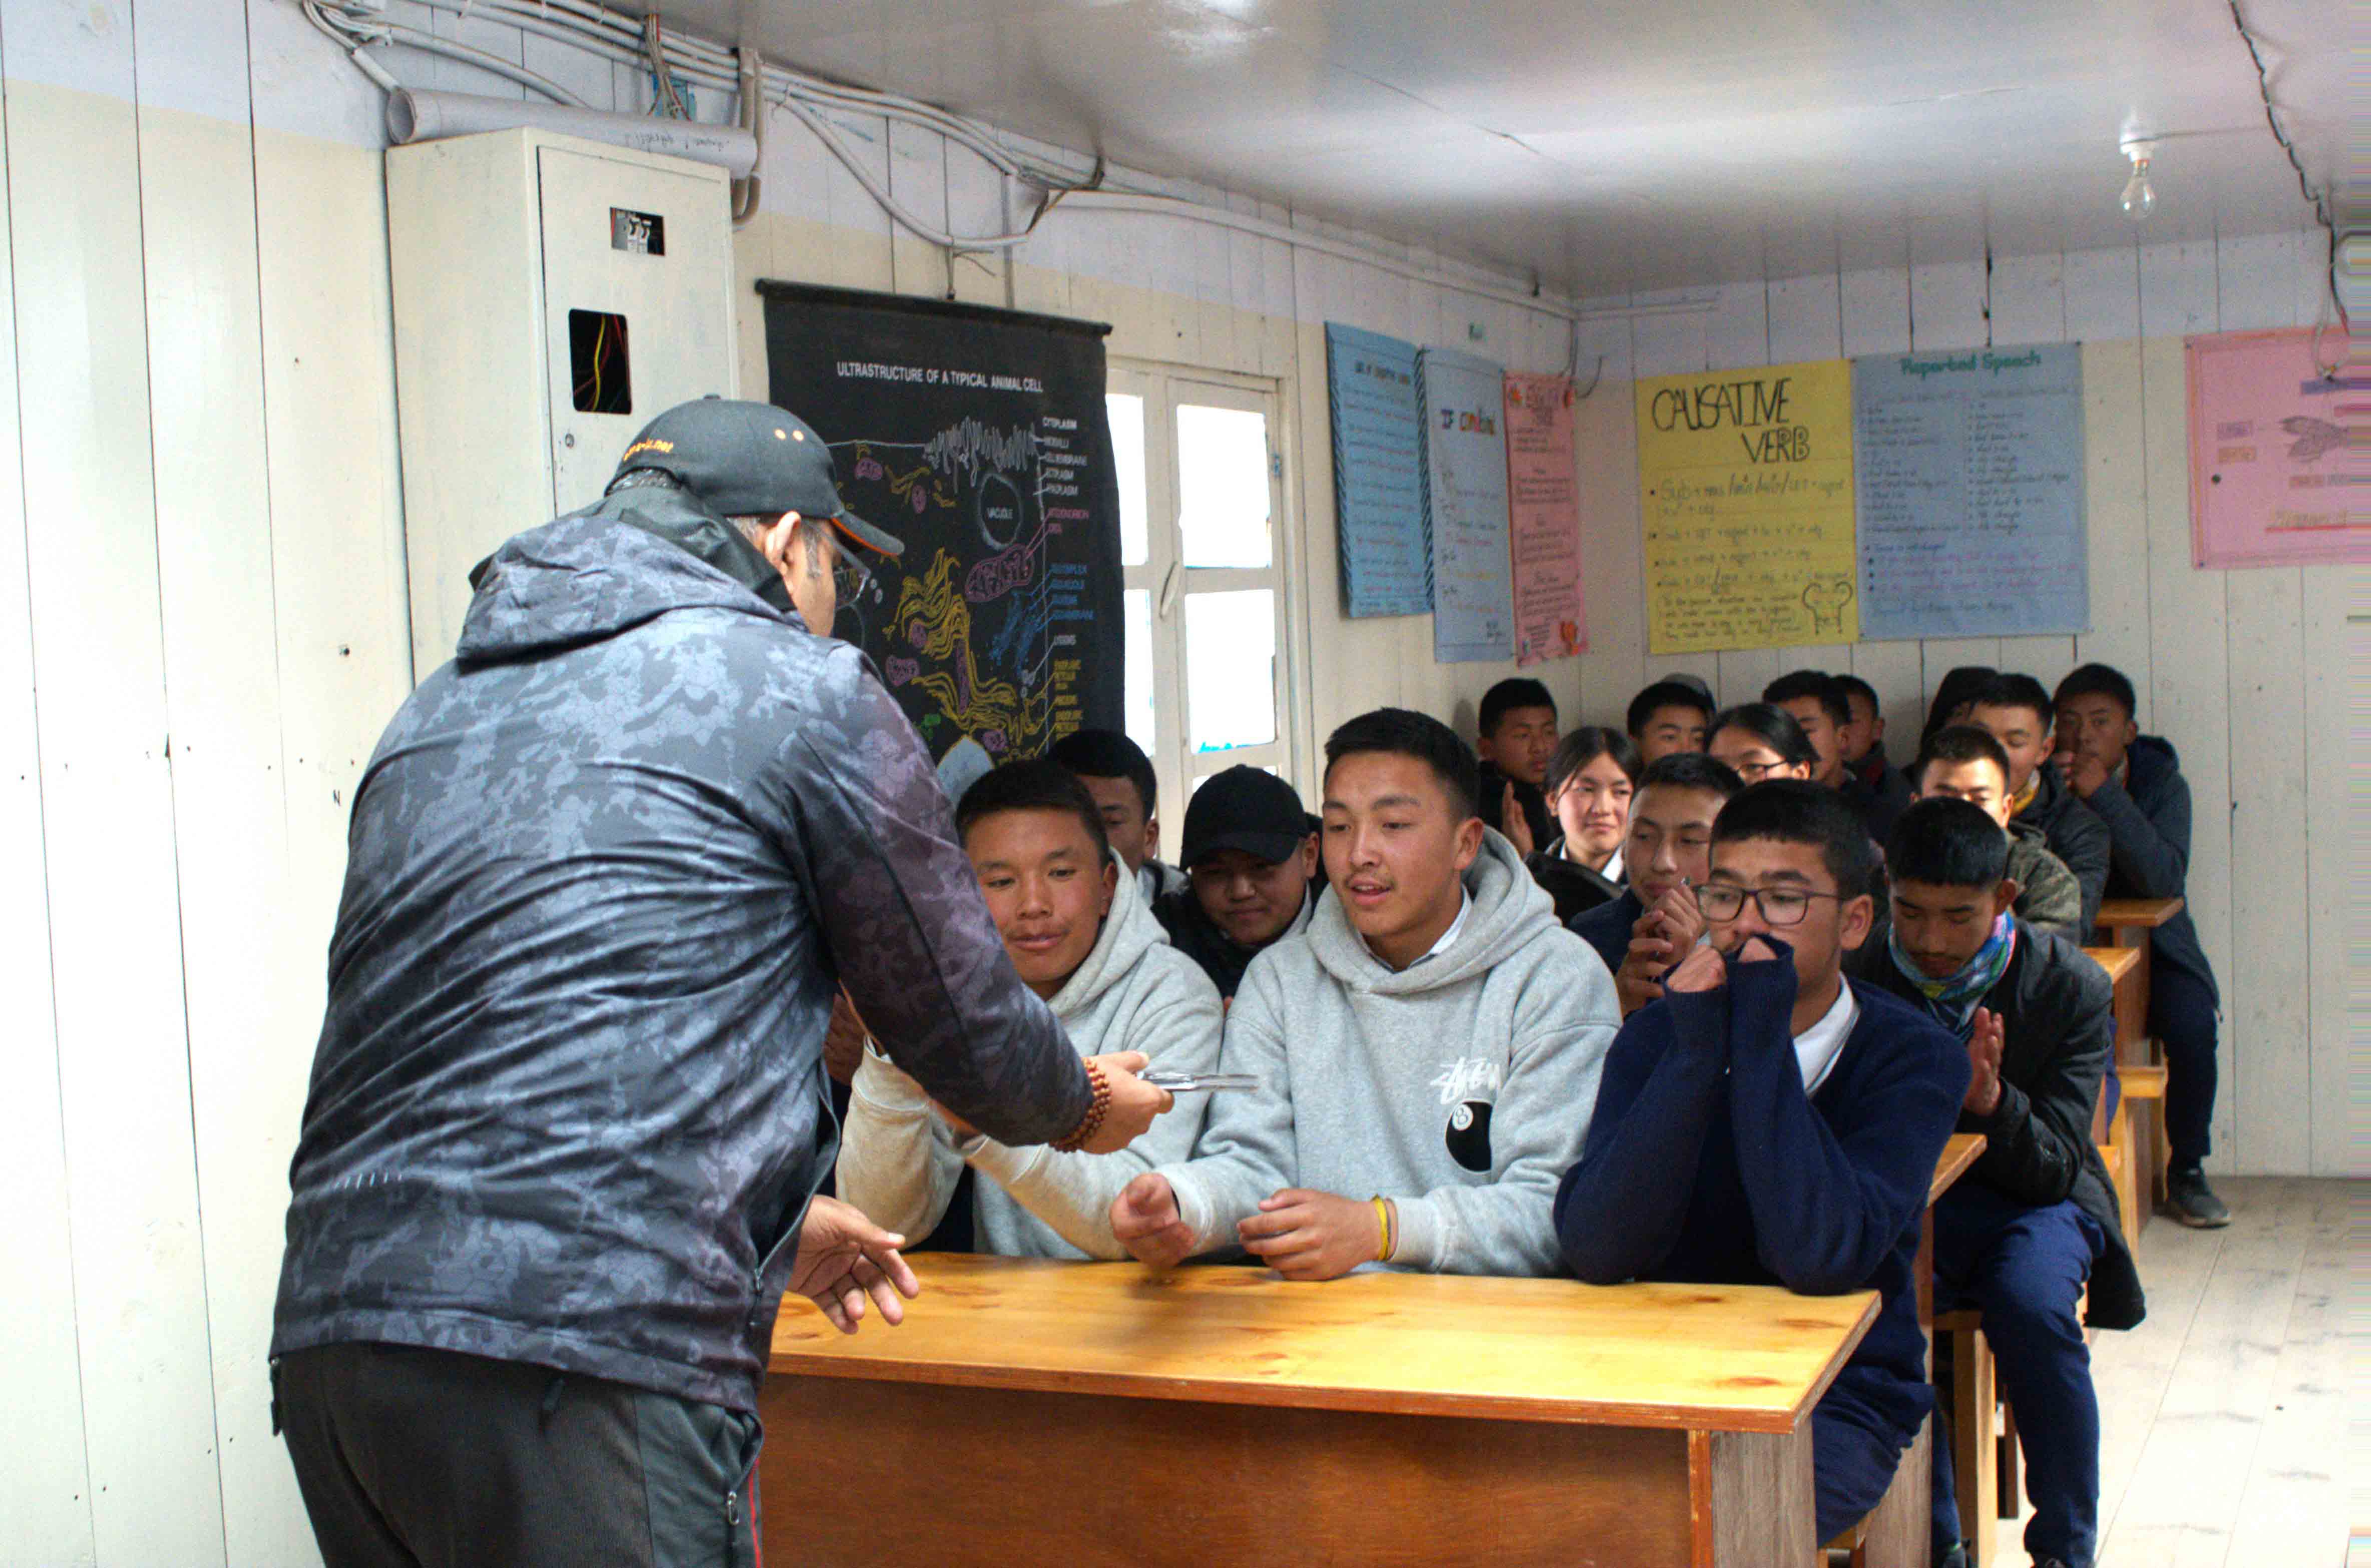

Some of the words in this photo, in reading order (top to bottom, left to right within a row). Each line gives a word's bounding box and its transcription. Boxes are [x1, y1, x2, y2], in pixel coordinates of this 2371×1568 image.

[837, 361, 923, 382] ULTRASTRUCTURE
[927, 369, 939, 383] OF
[942, 369, 949, 384] A
[951, 371, 988, 387] TYPICAL
[991, 375, 1022, 391] ANIMAL
[1023, 377, 1044, 393] CELL
[1652, 377, 1791, 431] CAUSATIVE
[1741, 426, 1810, 463] VERB
